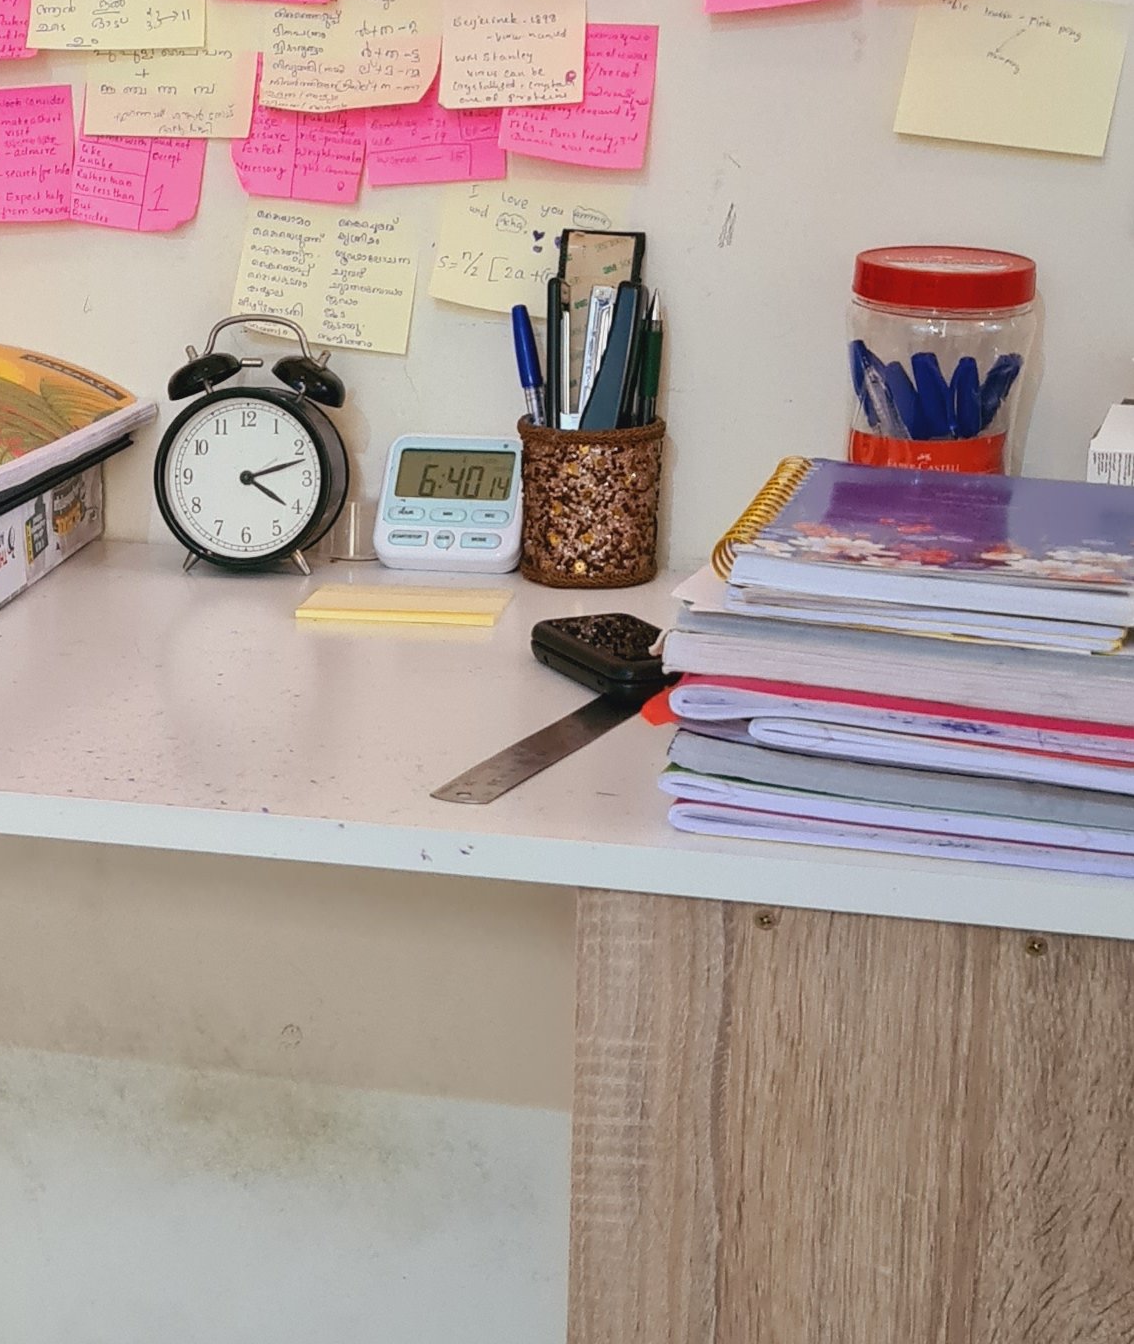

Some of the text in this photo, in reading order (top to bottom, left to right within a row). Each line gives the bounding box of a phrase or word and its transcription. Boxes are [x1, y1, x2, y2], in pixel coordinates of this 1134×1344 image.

[147, 184, 169, 211] 1
[469, 185, 479, 199] I
[469, 205, 490, 218] and
[502, 192, 565, 218] love you
[215, 419, 228, 435] 11
[241, 411, 257, 427] 12
[273, 419, 279, 434] 1
[195, 439, 209, 455] 10
[294, 440, 305, 456] 2
[183, 468, 193, 485] 9
[302, 470, 312, 487] 3
[418, 464, 510, 499] 6:40 14
[191, 496, 201, 514] 8
[291, 499, 303, 515] 4
[214, 520, 224, 536] 7
[241, 526, 251, 544] 6
[272, 520, 282, 537] 5
